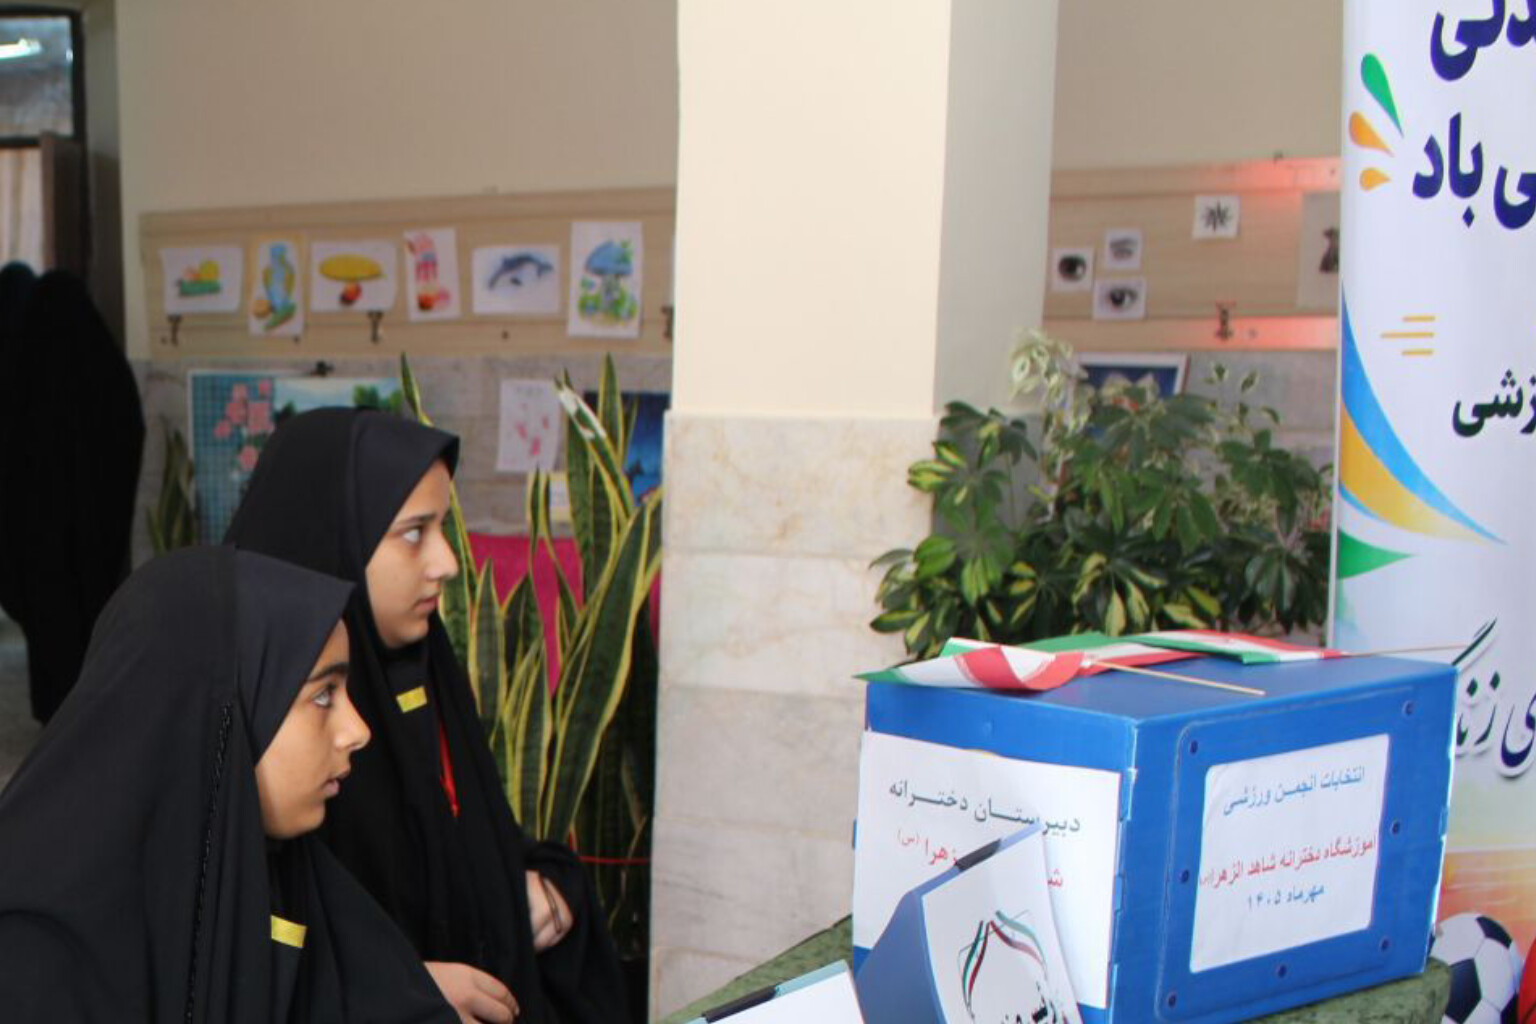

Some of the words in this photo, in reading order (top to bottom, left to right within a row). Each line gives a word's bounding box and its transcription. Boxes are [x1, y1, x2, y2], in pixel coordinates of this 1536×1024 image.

[1412, 112, 1484, 229] باد
[1275, 774, 1316, 803] انجمن
[1320, 766, 1365, 792] انتخابات
[889, 779, 968, 811] دخترانه
[1223, 785, 1271, 816] ورزشی
[974, 798, 1081, 836] دبیرستان
[1247, 854, 1277, 876] شاهد
[1279, 849, 1321, 871] دخترانه
